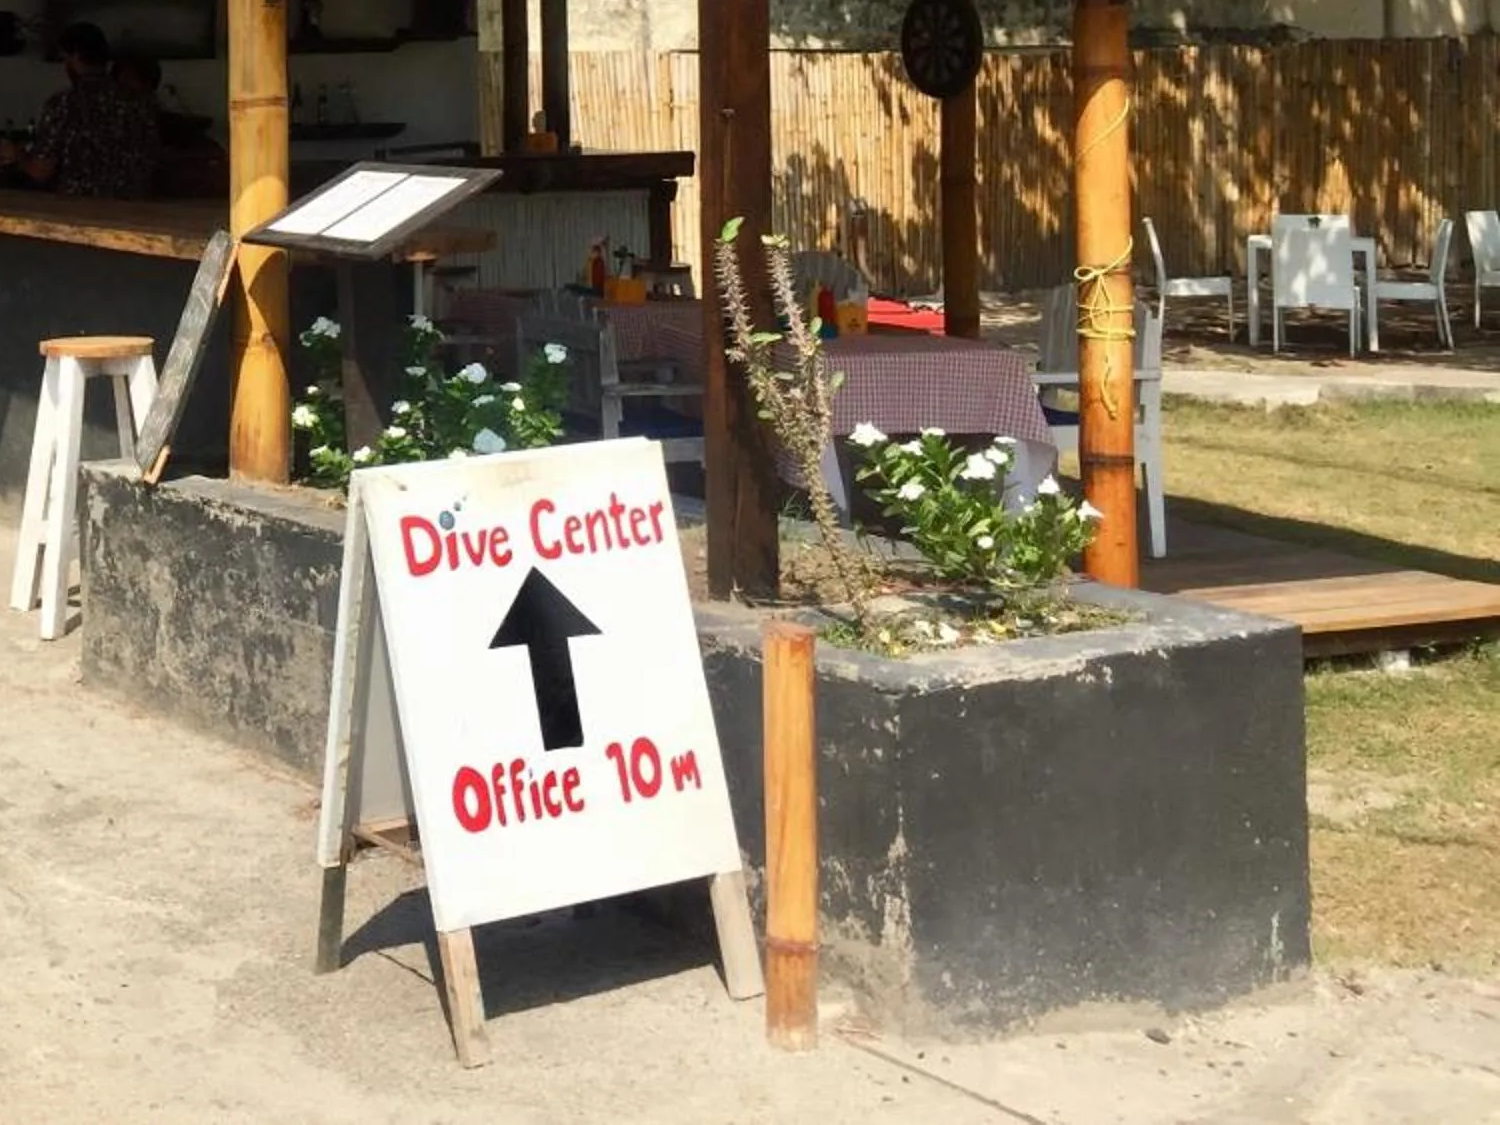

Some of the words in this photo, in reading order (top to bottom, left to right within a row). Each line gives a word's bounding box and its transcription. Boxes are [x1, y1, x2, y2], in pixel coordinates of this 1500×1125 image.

[400, 509, 513, 576] Dive
[529, 492, 664, 560] Center
[452, 757, 585, 833] Office
[605, 736, 662, 803] 10
